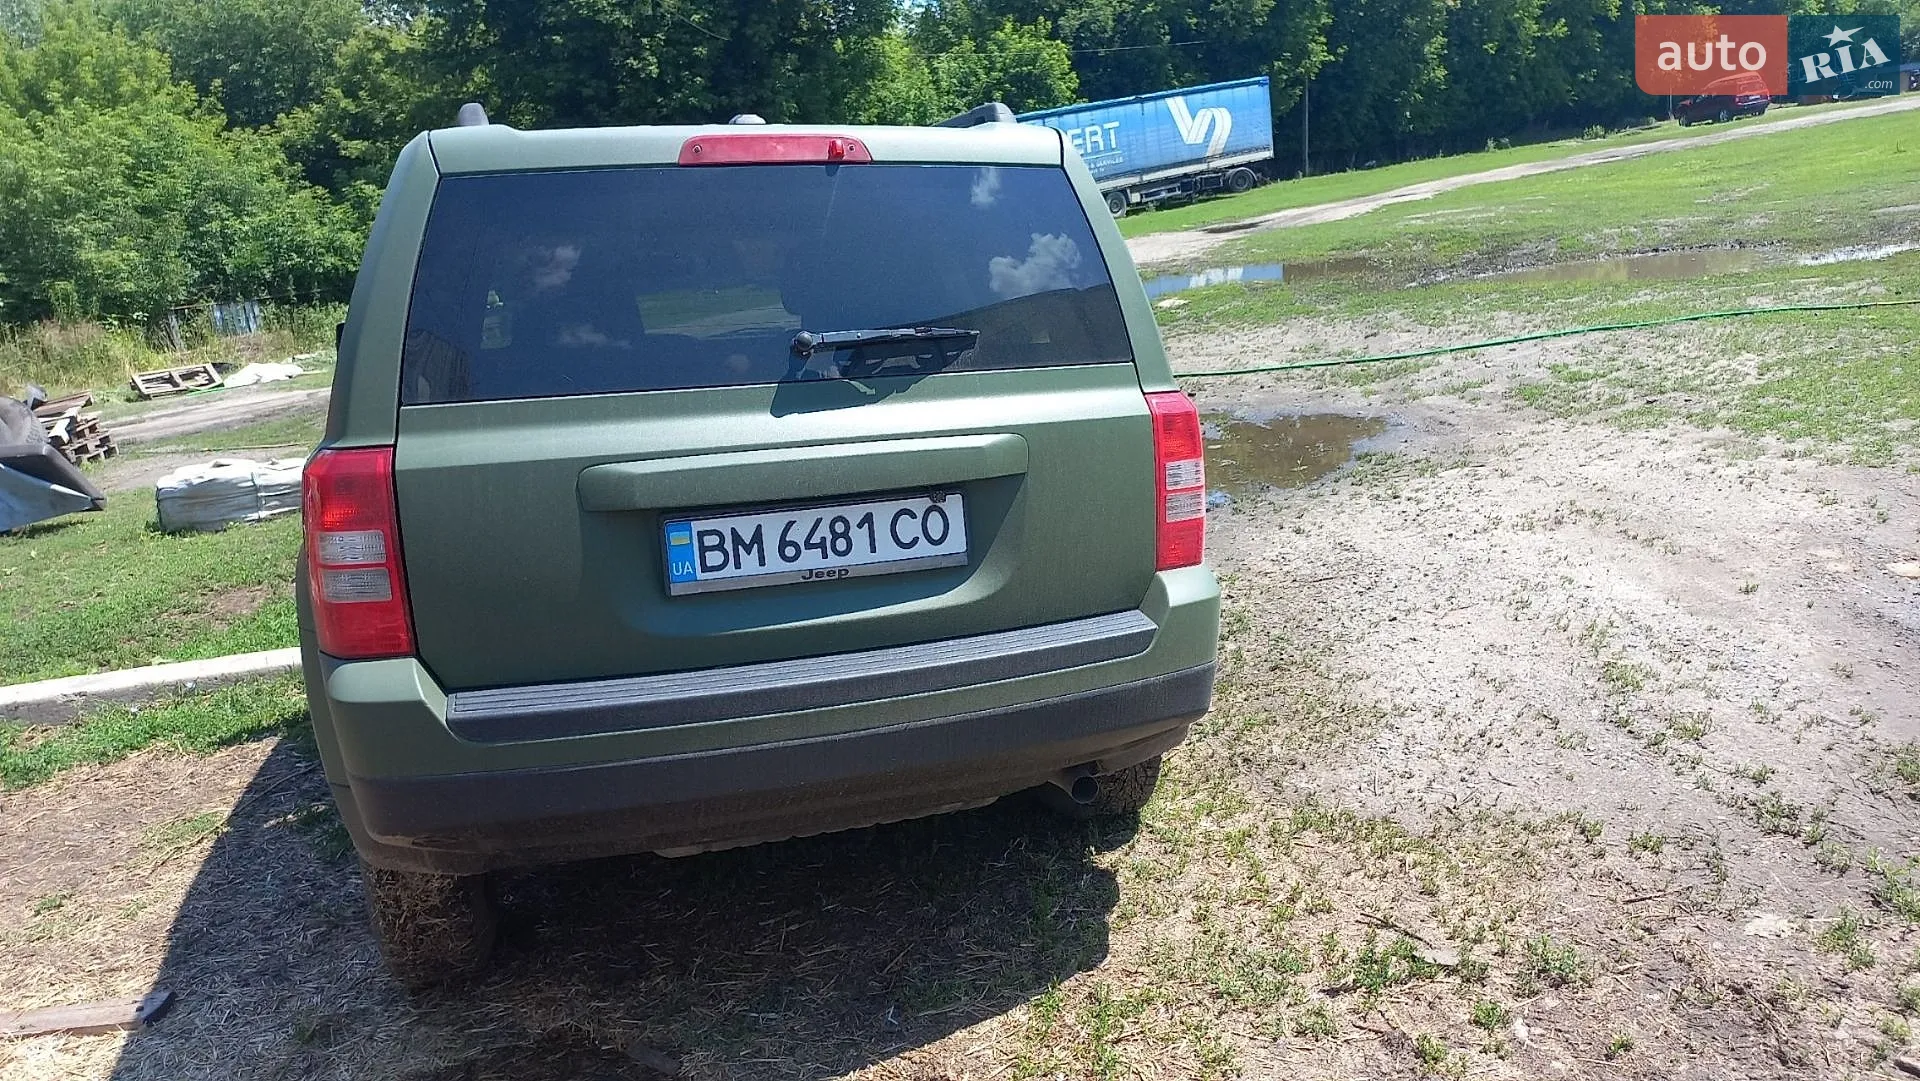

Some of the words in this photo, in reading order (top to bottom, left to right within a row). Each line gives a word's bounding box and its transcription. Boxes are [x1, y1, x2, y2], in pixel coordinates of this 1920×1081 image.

[697, 523, 767, 574] BM
[777, 511, 877, 563] 6481
[890, 504, 950, 550] CO
[672, 561, 694, 576] UA
[801, 567, 850, 580] Jeep
